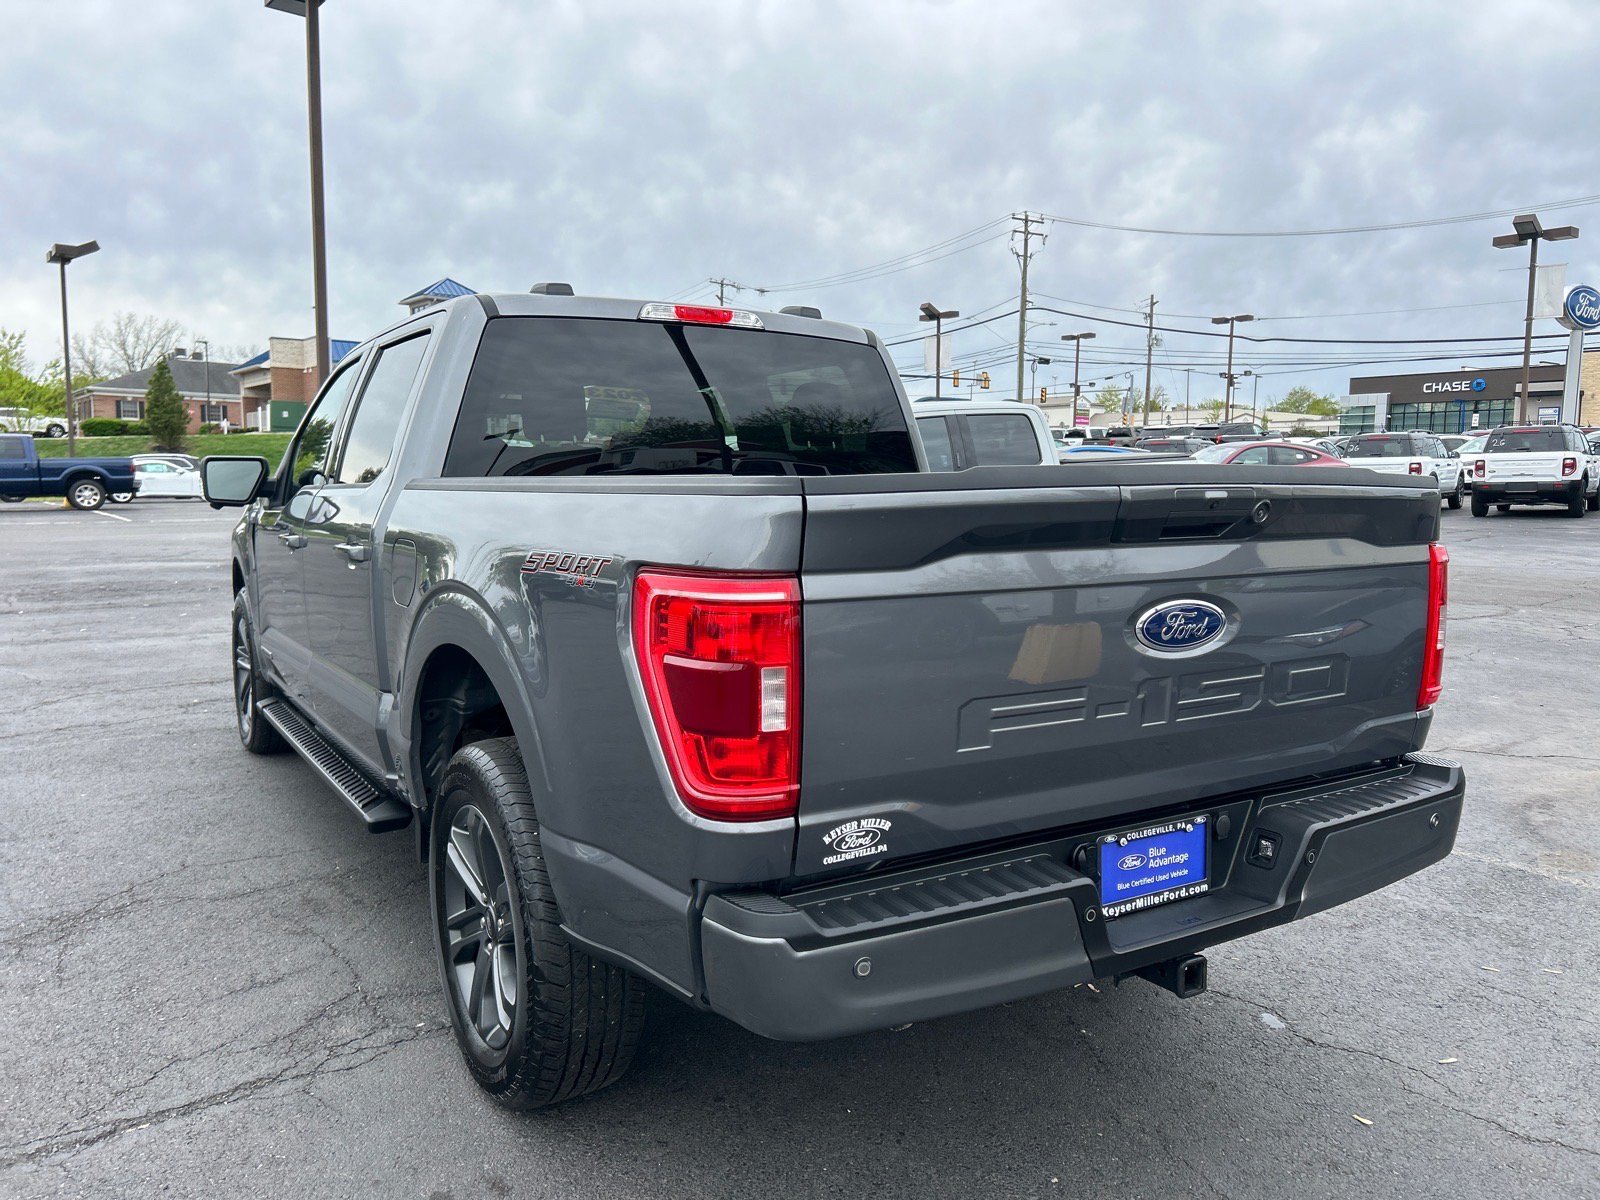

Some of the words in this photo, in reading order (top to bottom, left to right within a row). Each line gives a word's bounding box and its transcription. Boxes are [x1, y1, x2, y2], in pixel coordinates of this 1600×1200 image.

[1575, 292, 1600, 321] Ford
[1423, 381, 1471, 393] CHASE
[520, 550, 613, 577] SPORT
[1161, 611, 1208, 641] Ford
[956, 652, 1350, 753] F-150
[822, 821, 858, 845] KEYSER
[860, 818, 892, 831] MILLER
[841, 831, 873, 849] Ford
[1126, 825, 1175, 840] COLLEGEVILLE,
[1177, 822, 1186, 830] PA
[1122, 856, 1142, 869] Ford
[1148, 847, 1167, 858] Blue
[1148, 853, 1189, 869] Advantage
[1117, 881, 1130, 891] Blue
[1131, 876, 1155, 888] Certified
[1155, 872, 1169, 882] Used
[1170, 868, 1189, 878] Vehicle
[1102, 884, 1208, 917] KeyserMillerFord.com
